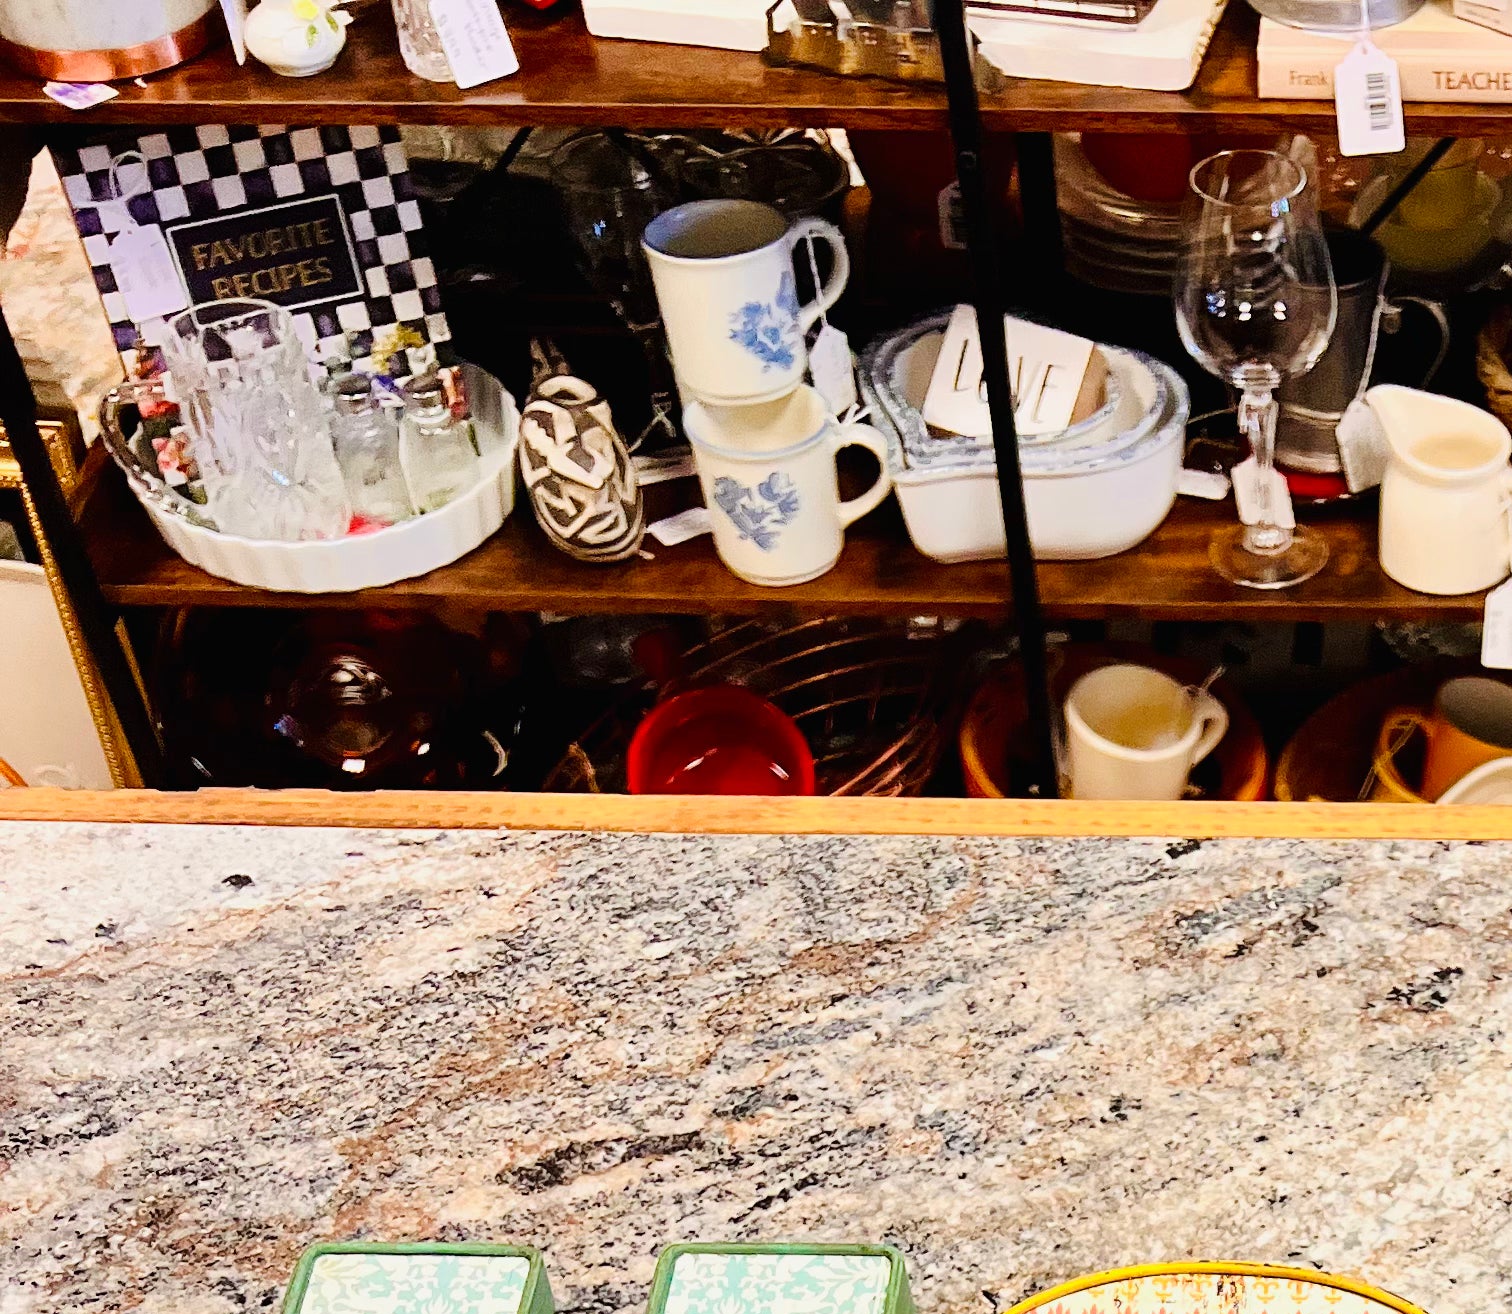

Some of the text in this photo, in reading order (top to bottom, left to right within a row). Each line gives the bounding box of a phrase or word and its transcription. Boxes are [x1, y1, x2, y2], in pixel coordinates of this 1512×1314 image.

[192, 218, 334, 271] FAVORITE
[212, 256, 333, 300] RECIPES
[953, 338, 1067, 424] LVE
